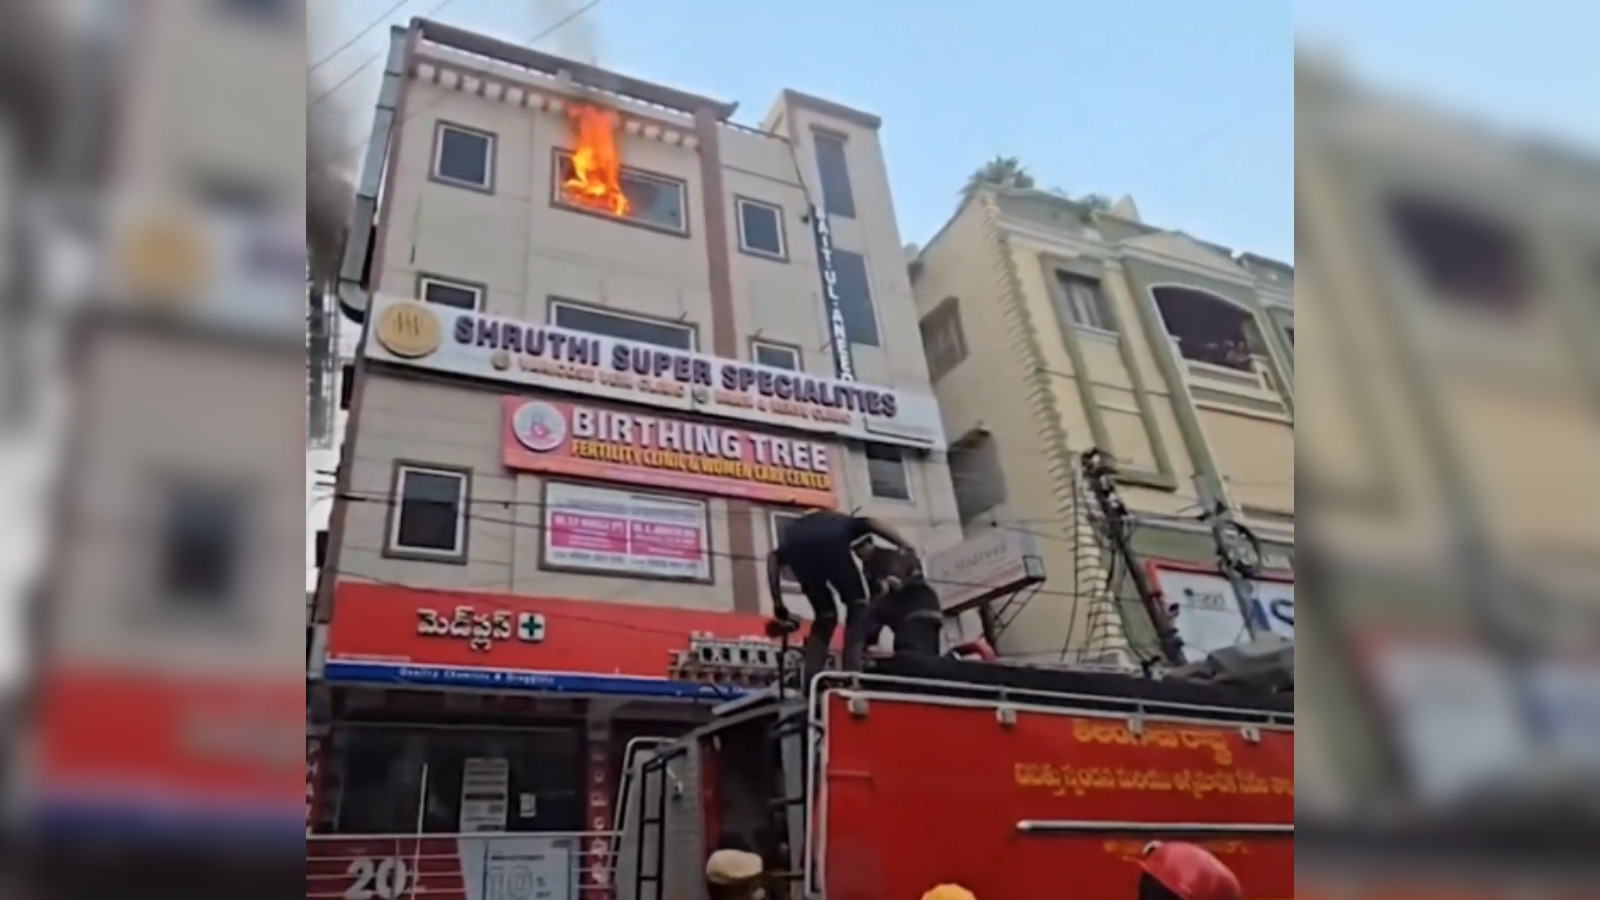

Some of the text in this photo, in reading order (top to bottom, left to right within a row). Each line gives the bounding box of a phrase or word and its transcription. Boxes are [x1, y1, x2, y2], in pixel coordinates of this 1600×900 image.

[454, 315, 600, 367] SHRUTHI
[612, 345, 712, 386] SUPER
[721, 365, 897, 418] SPECIALITIES
[571, 439, 642, 465] FERTILITY
[643, 450, 687, 473] CLINIC
[701, 459, 750, 481] WOMEN
[754, 465, 785, 486] CARE
[787, 470, 831, 491] CENTER
[572, 407, 741, 461] BIRTHING
[750, 434, 828, 472] TREE
